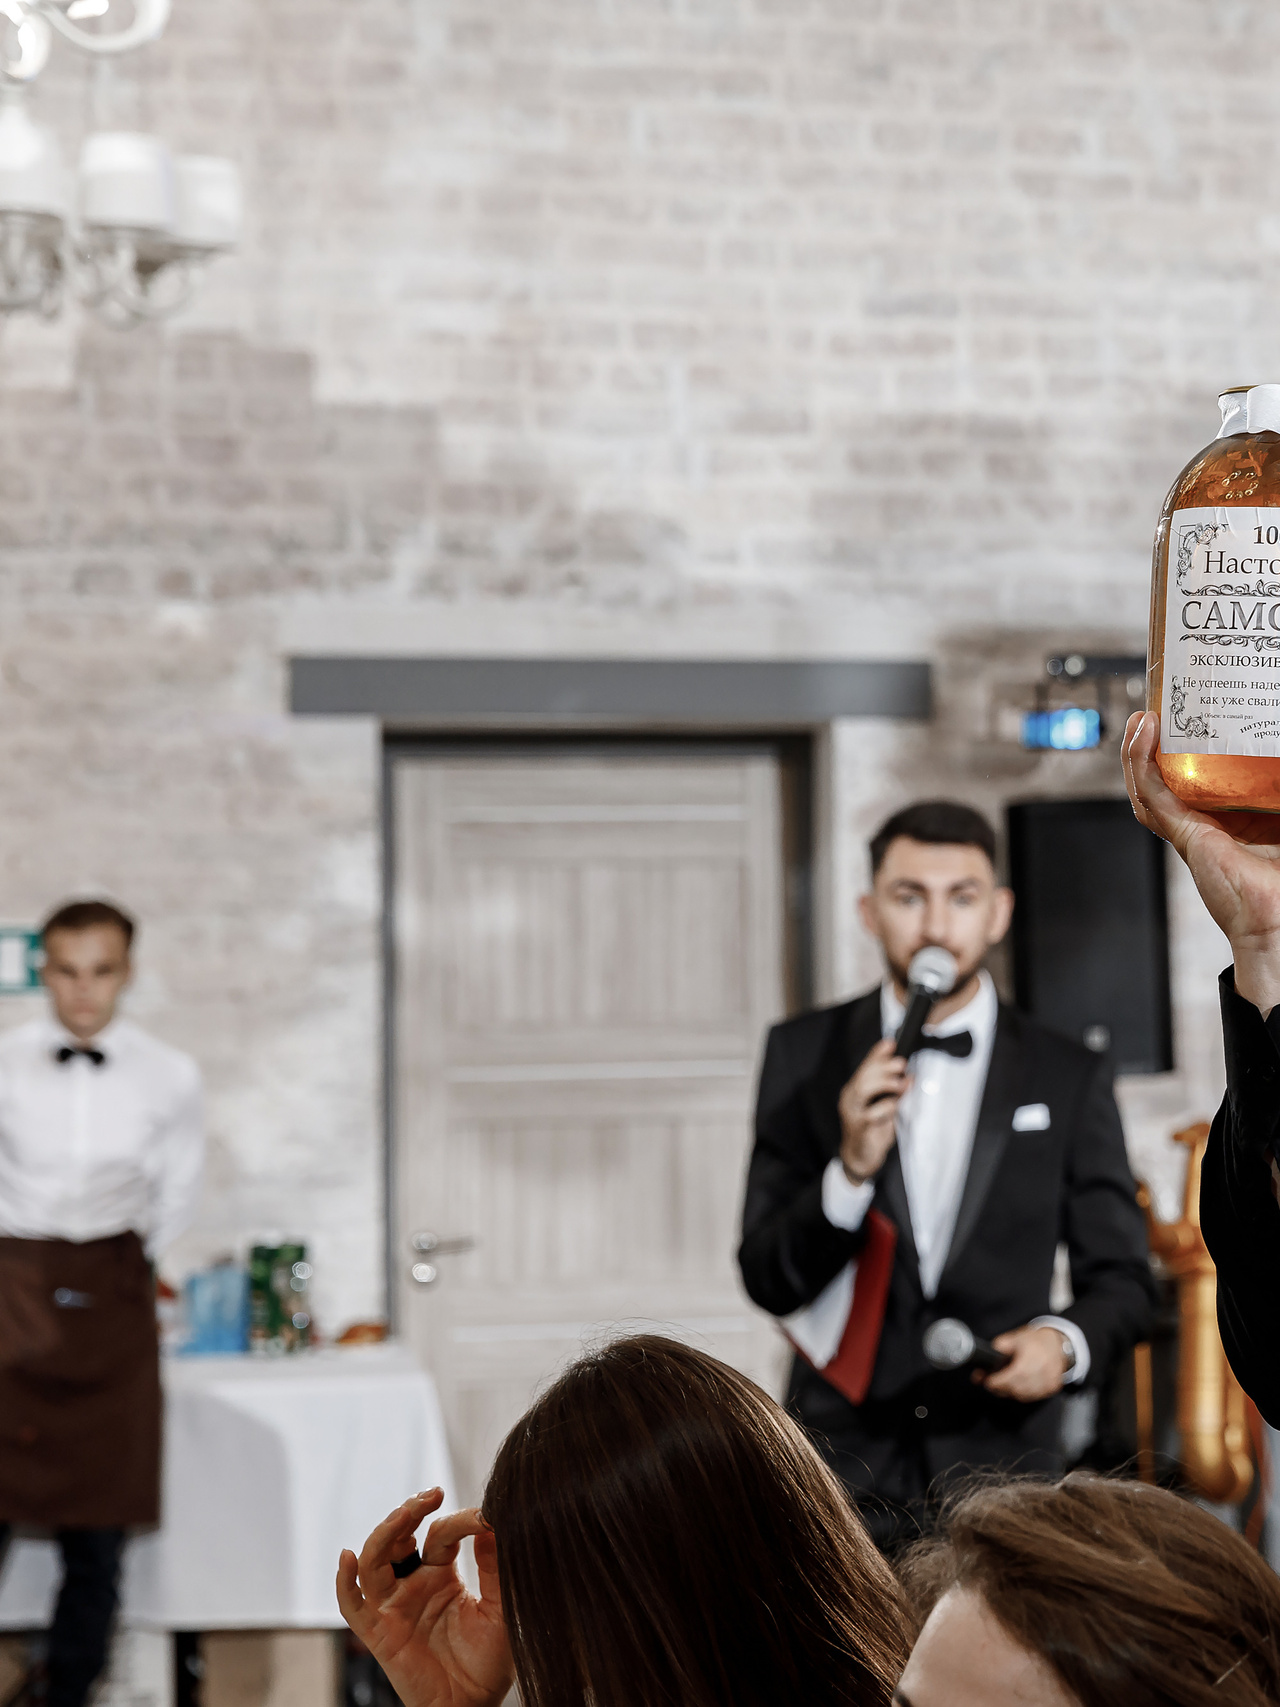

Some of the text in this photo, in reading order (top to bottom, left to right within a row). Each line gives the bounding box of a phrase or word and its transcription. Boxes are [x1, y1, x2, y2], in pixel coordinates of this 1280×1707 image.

[1182, 676, 1197, 688] Не
[1198, 680, 1247, 691] успеешь
[1200, 696, 1219, 705] как
[1221, 696, 1245, 708] уже
